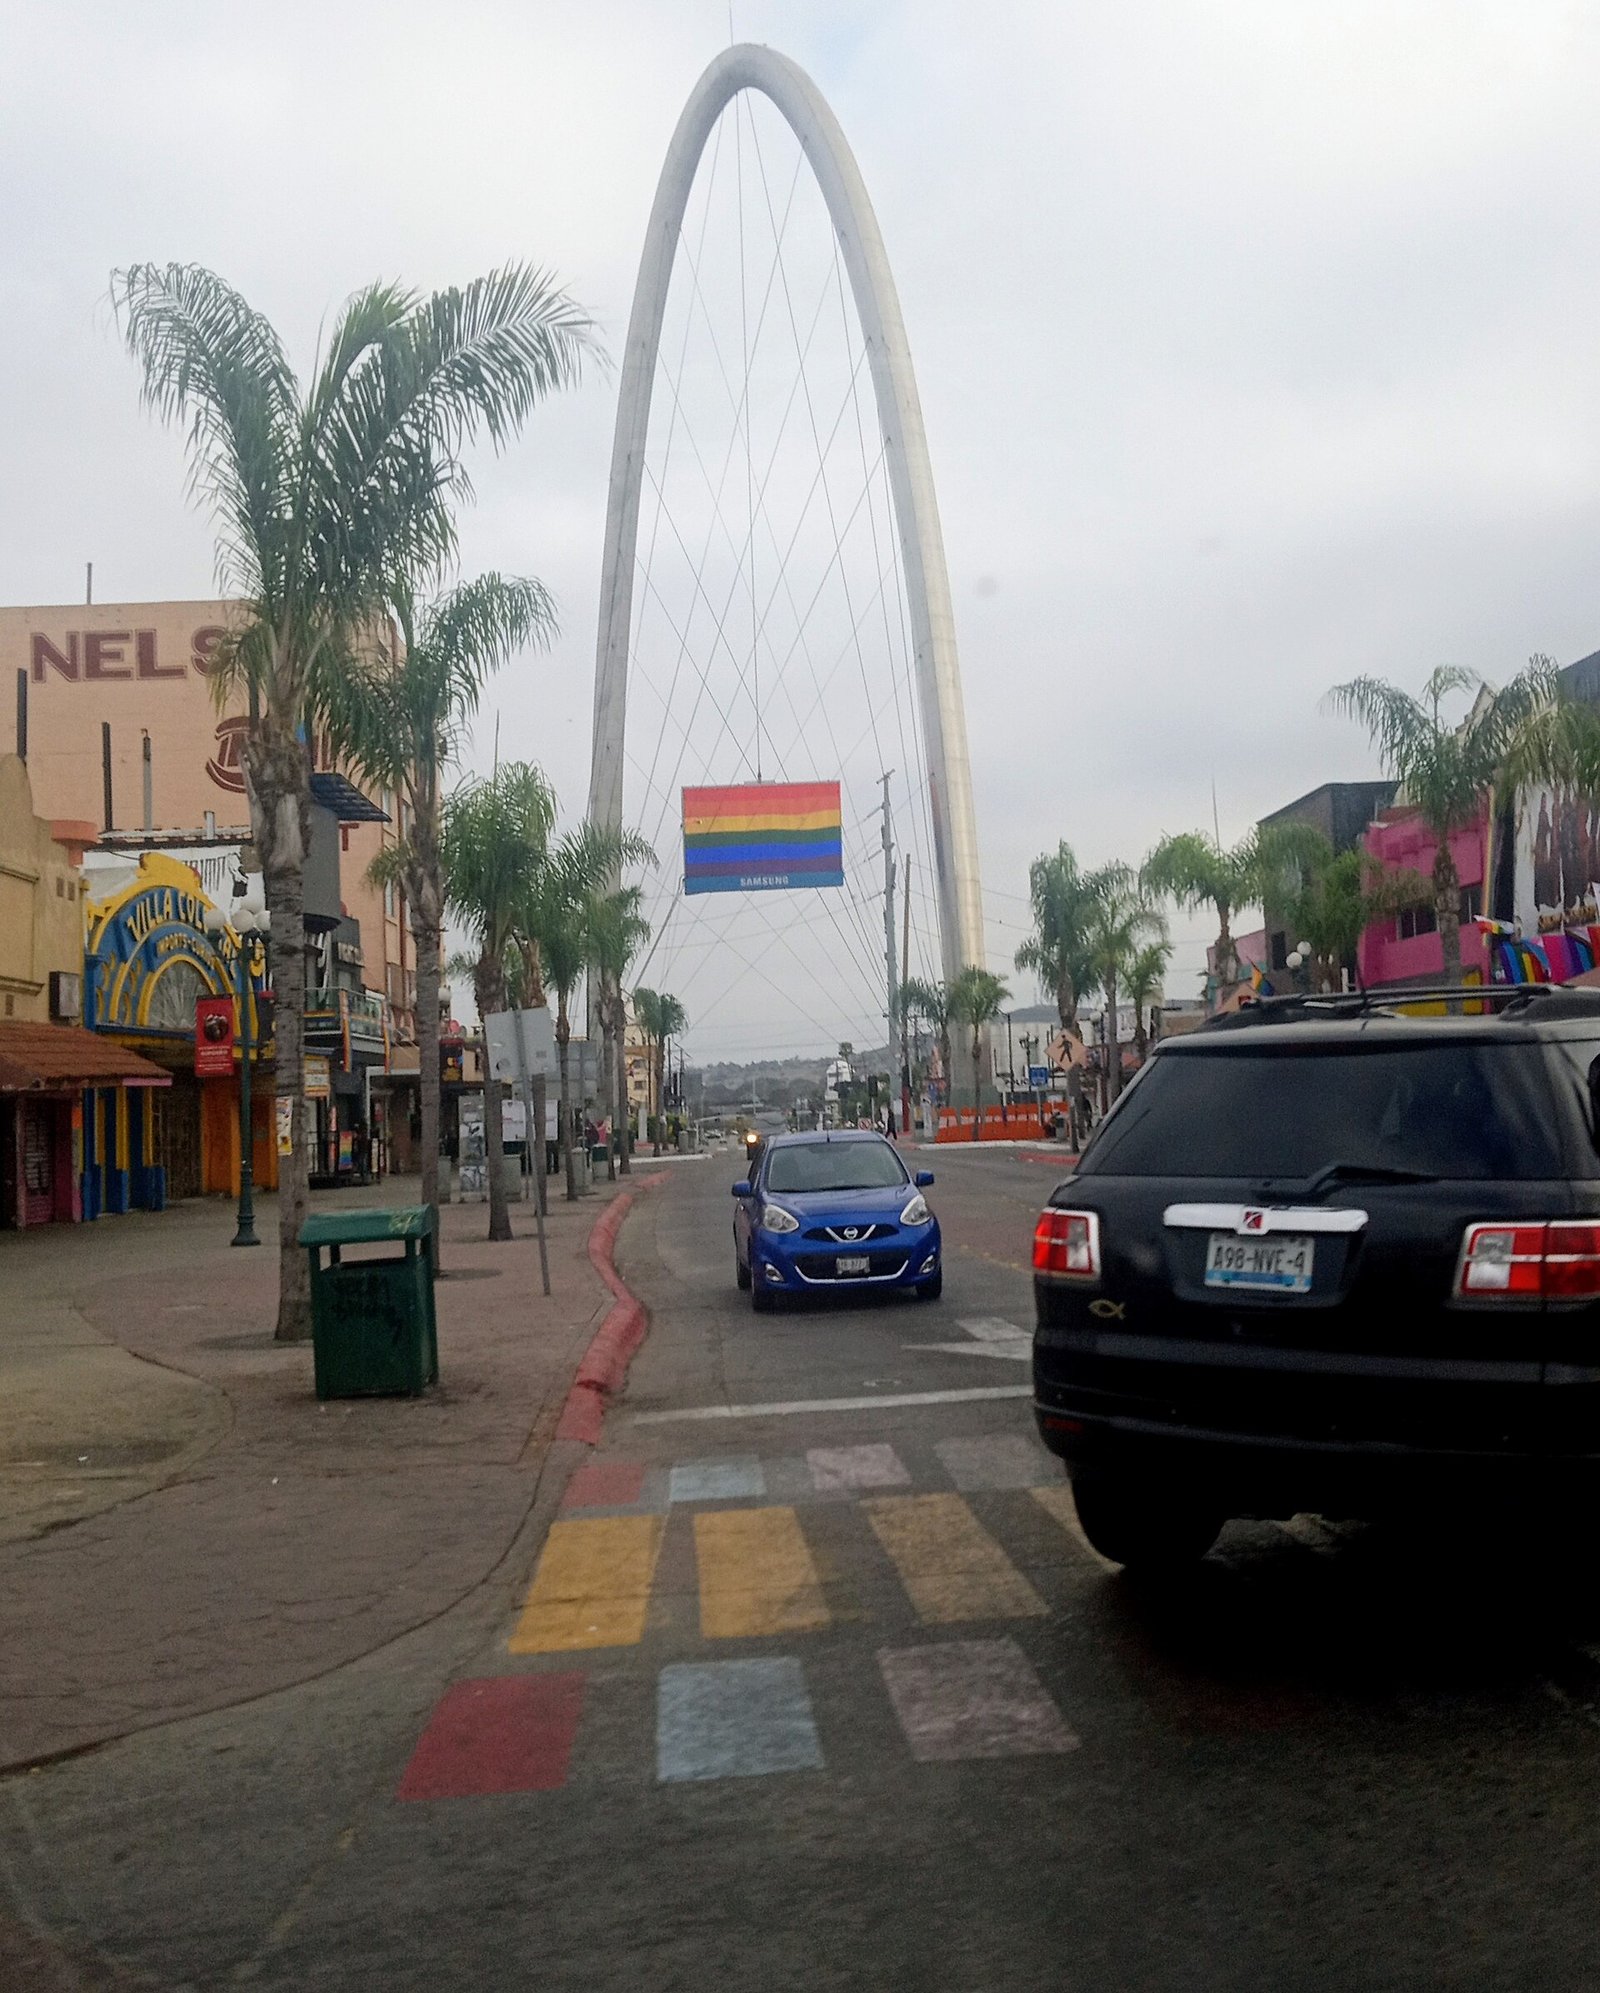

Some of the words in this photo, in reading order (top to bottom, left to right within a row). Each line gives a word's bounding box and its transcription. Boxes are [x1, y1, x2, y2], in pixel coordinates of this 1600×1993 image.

[30, 625, 236, 684] NELS
[741, 875, 789, 887] SAMSUNG
[126, 888, 172, 943] VILLA
